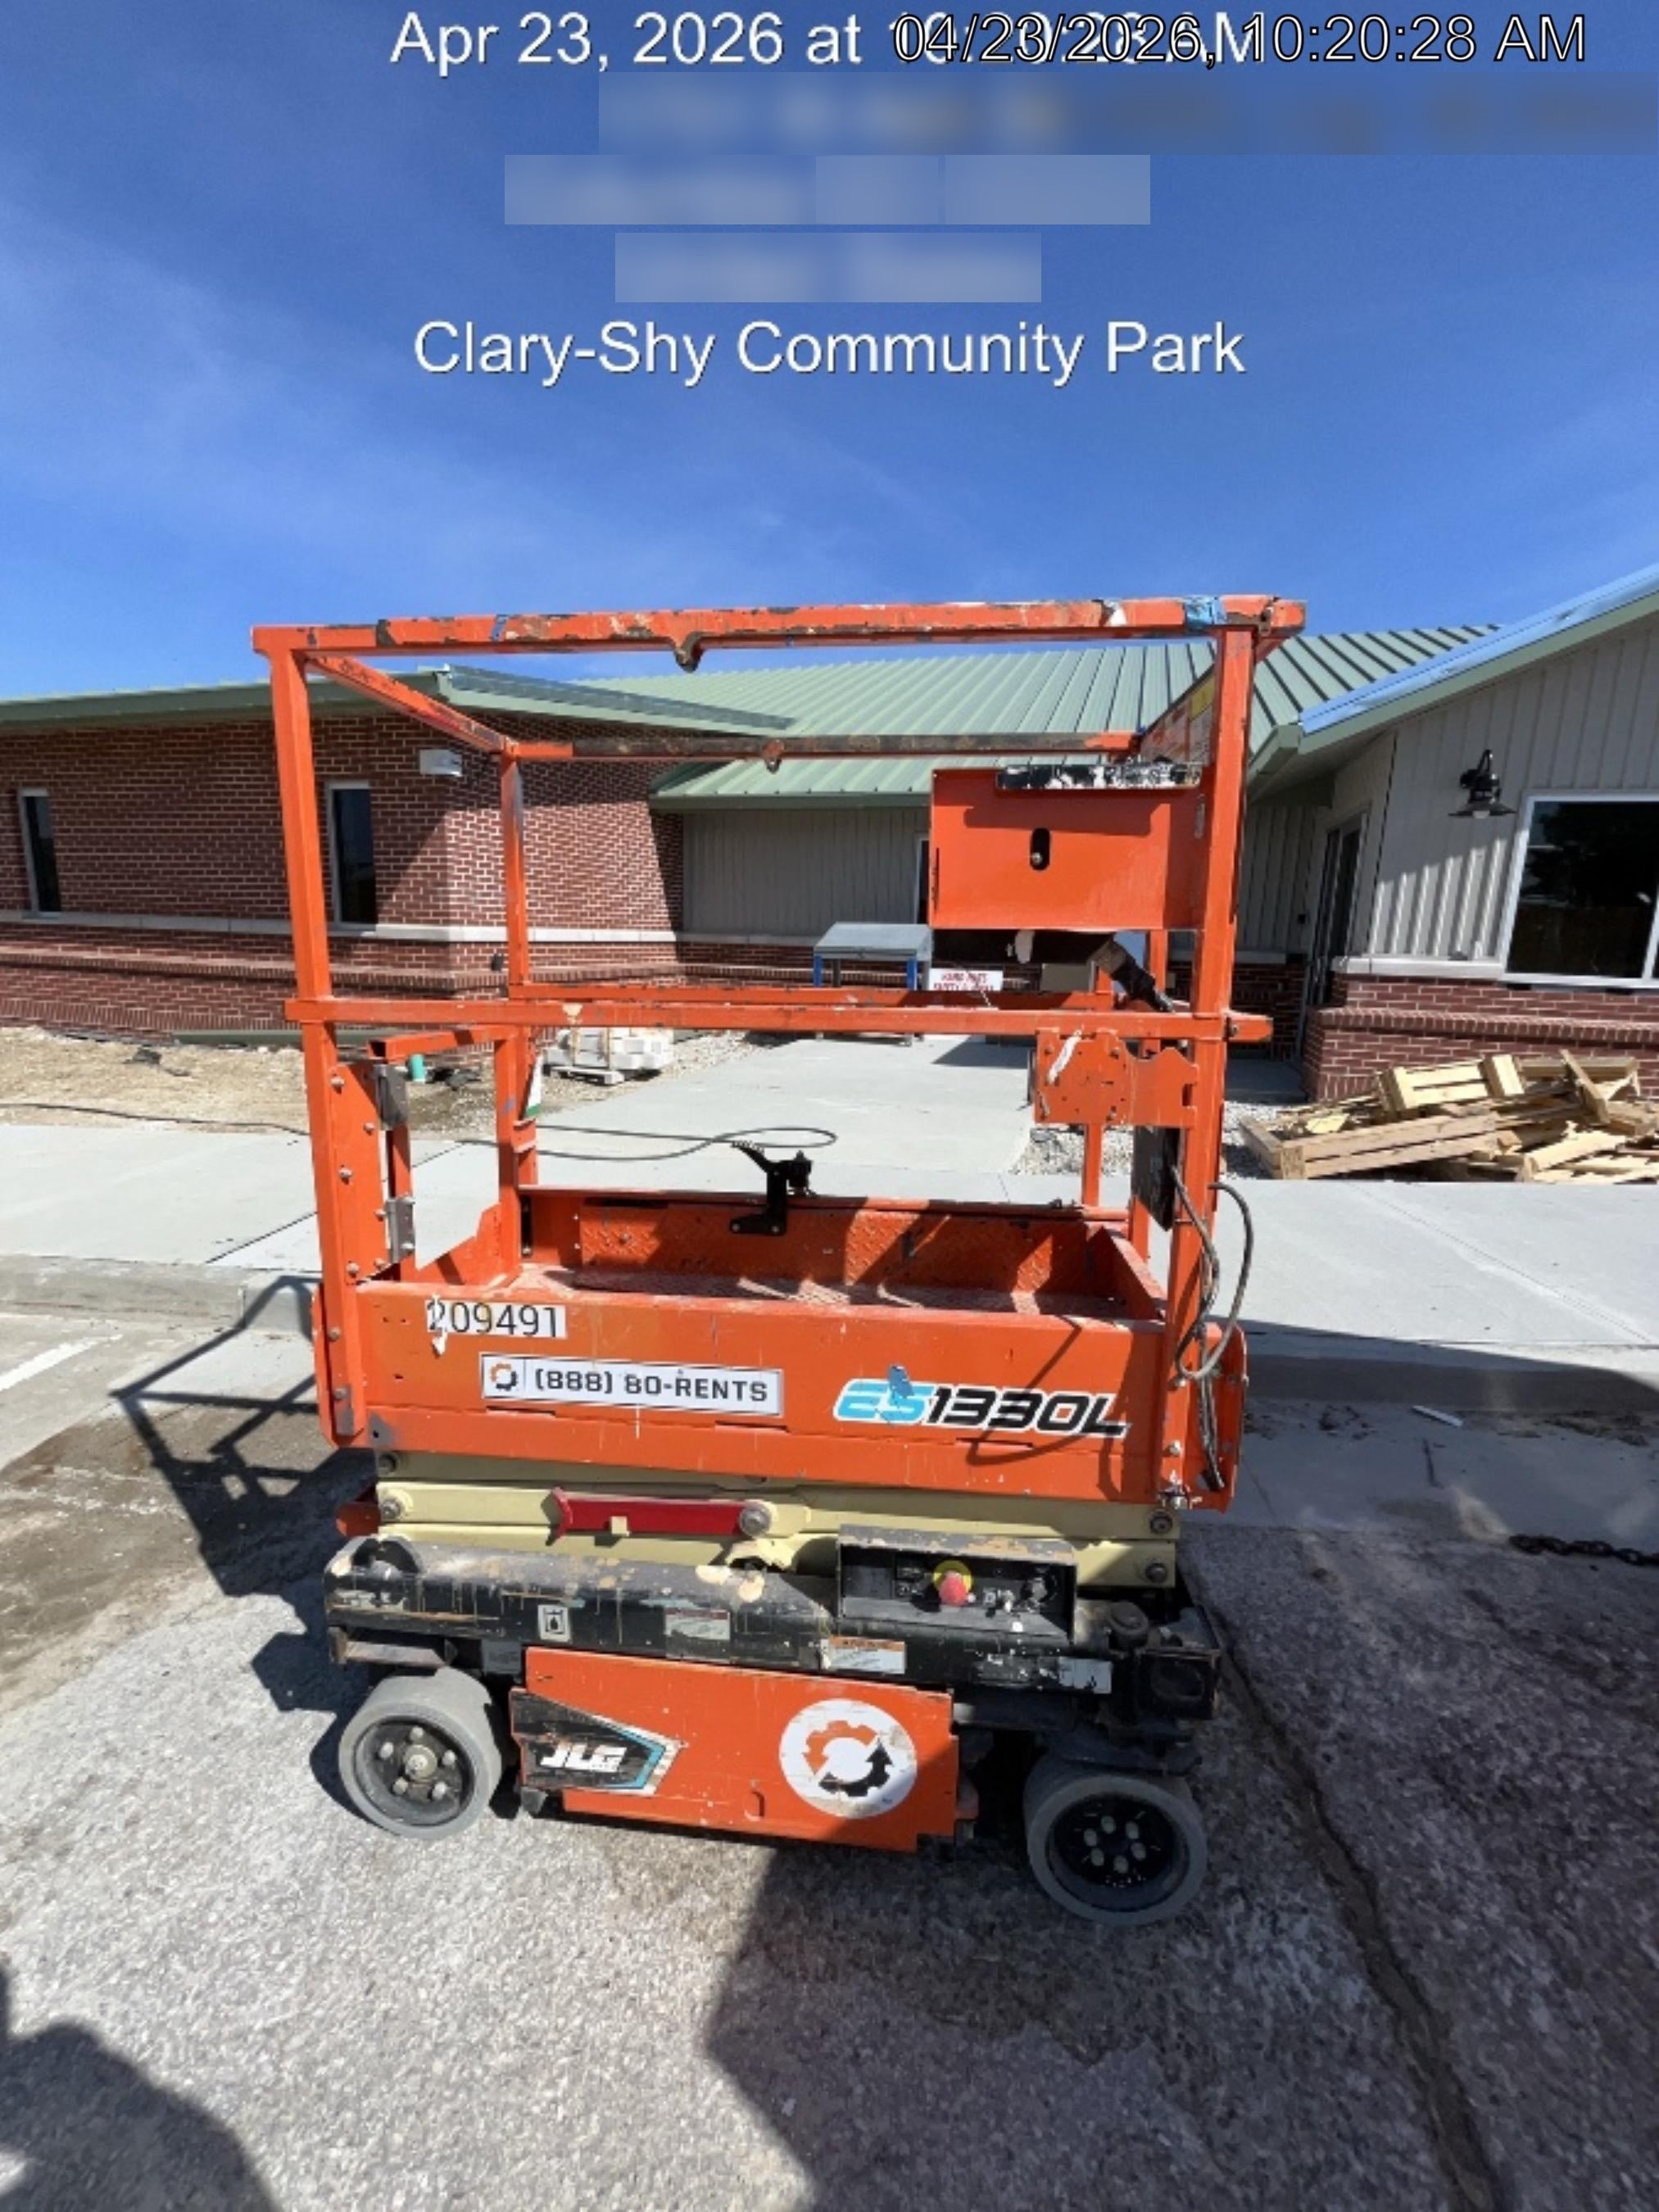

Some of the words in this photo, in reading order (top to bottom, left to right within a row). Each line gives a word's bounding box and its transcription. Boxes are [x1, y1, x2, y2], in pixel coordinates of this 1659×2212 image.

[534, 1367, 613, 1394] (888)
[623, 1374, 768, 1403] 80-RENTS
[834, 1378, 1131, 1437] ES1330L
[539, 1741, 628, 1774] JLG
